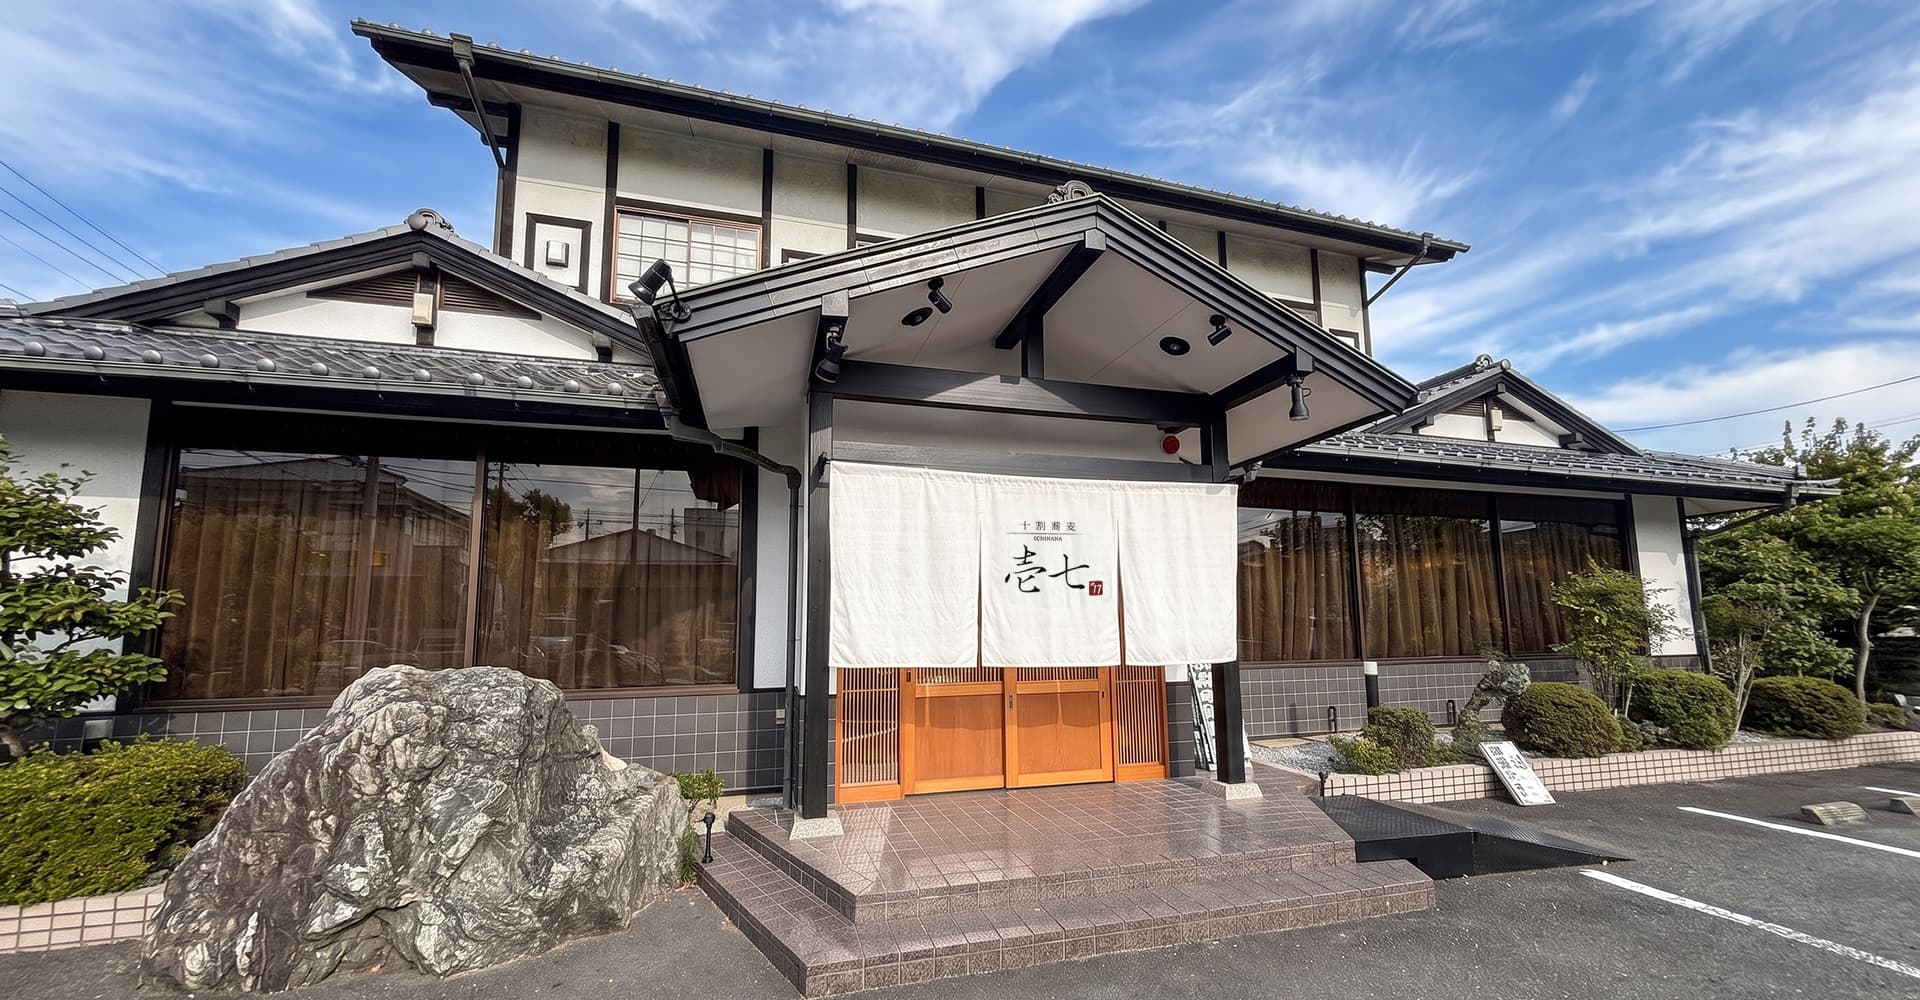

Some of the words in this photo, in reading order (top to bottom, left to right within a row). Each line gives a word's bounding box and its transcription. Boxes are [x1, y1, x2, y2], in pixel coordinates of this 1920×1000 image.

[1019, 520, 1076, 531] 十割蕎麦
[1004, 544, 1089, 593] 壱七
